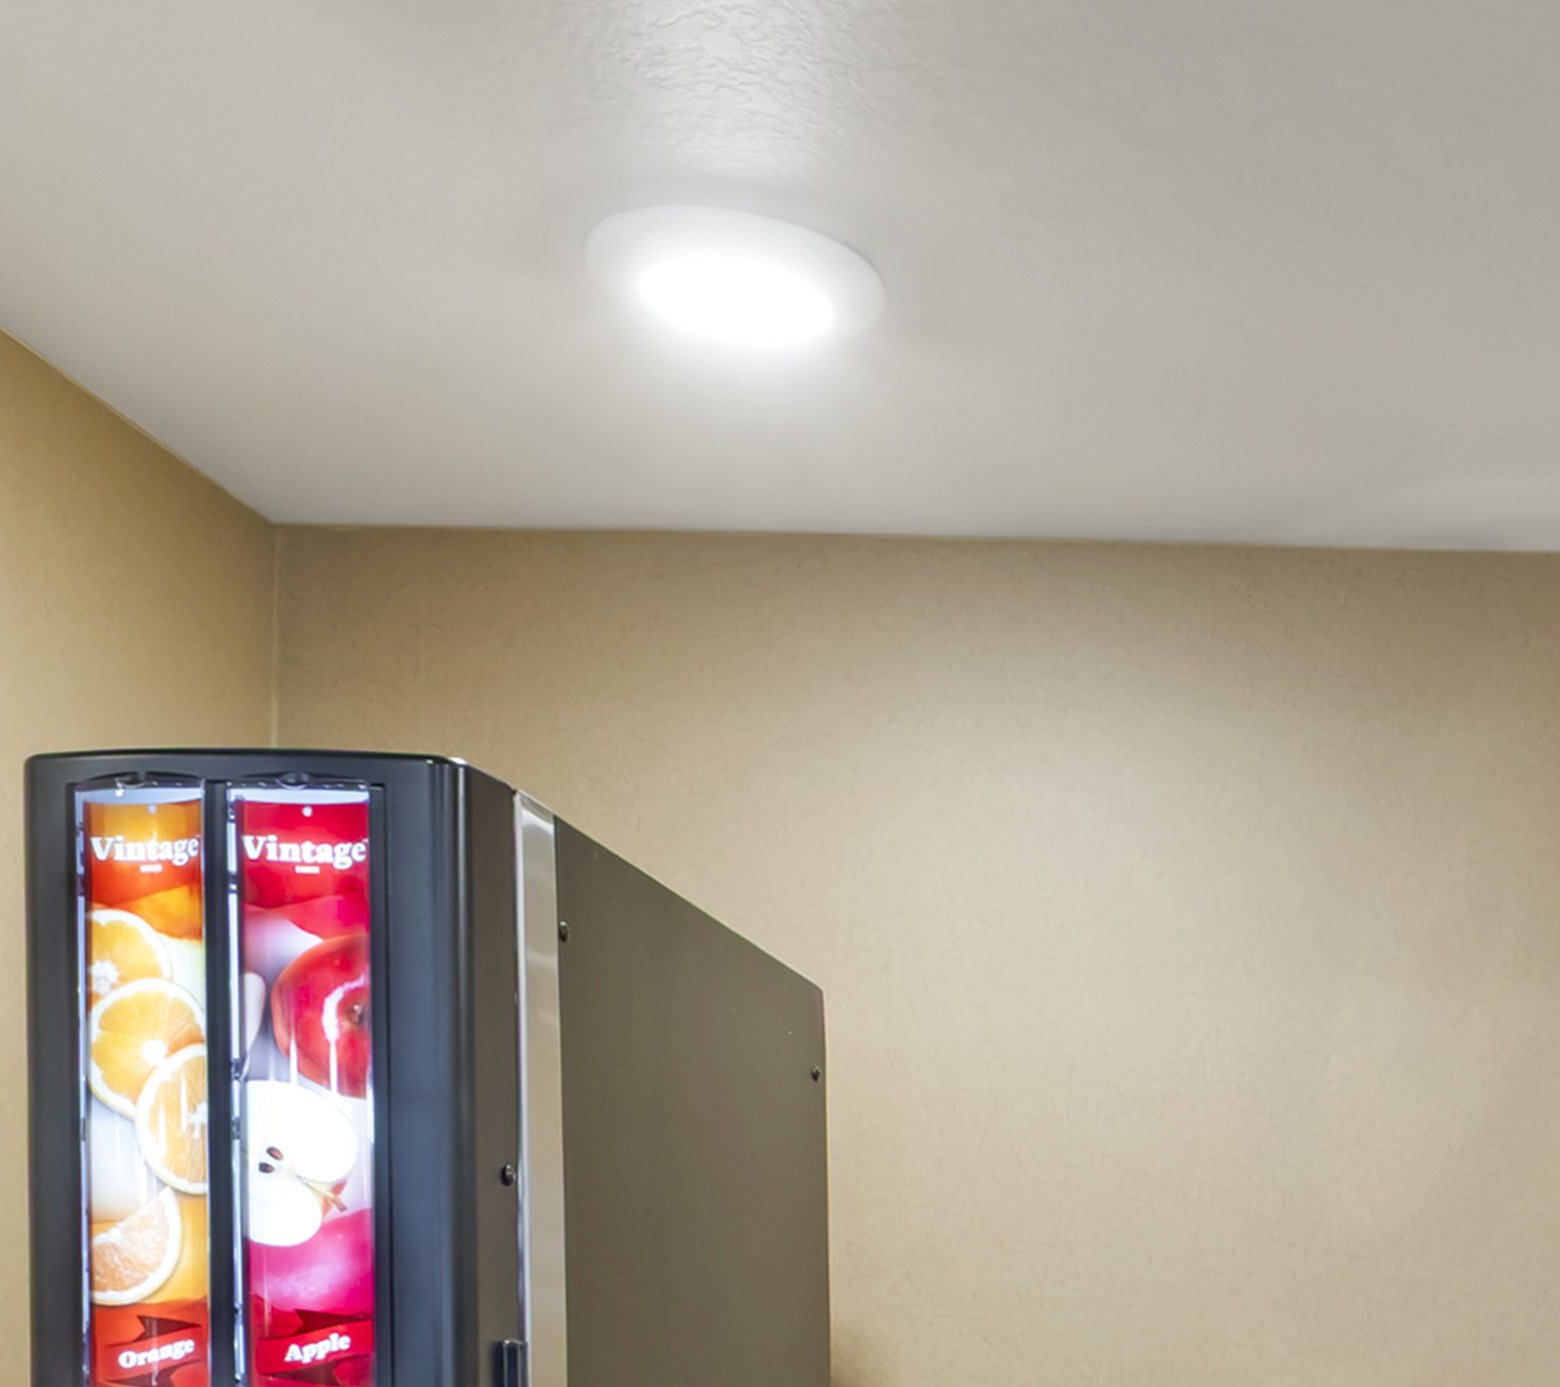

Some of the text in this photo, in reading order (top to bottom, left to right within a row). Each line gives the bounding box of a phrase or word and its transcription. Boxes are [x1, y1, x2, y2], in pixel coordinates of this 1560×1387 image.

[90, 836, 198, 865] Vintage
[242, 835, 366, 868] Vintage
[118, 1338, 195, 1368] Orange
[284, 1333, 351, 1363] Apple
